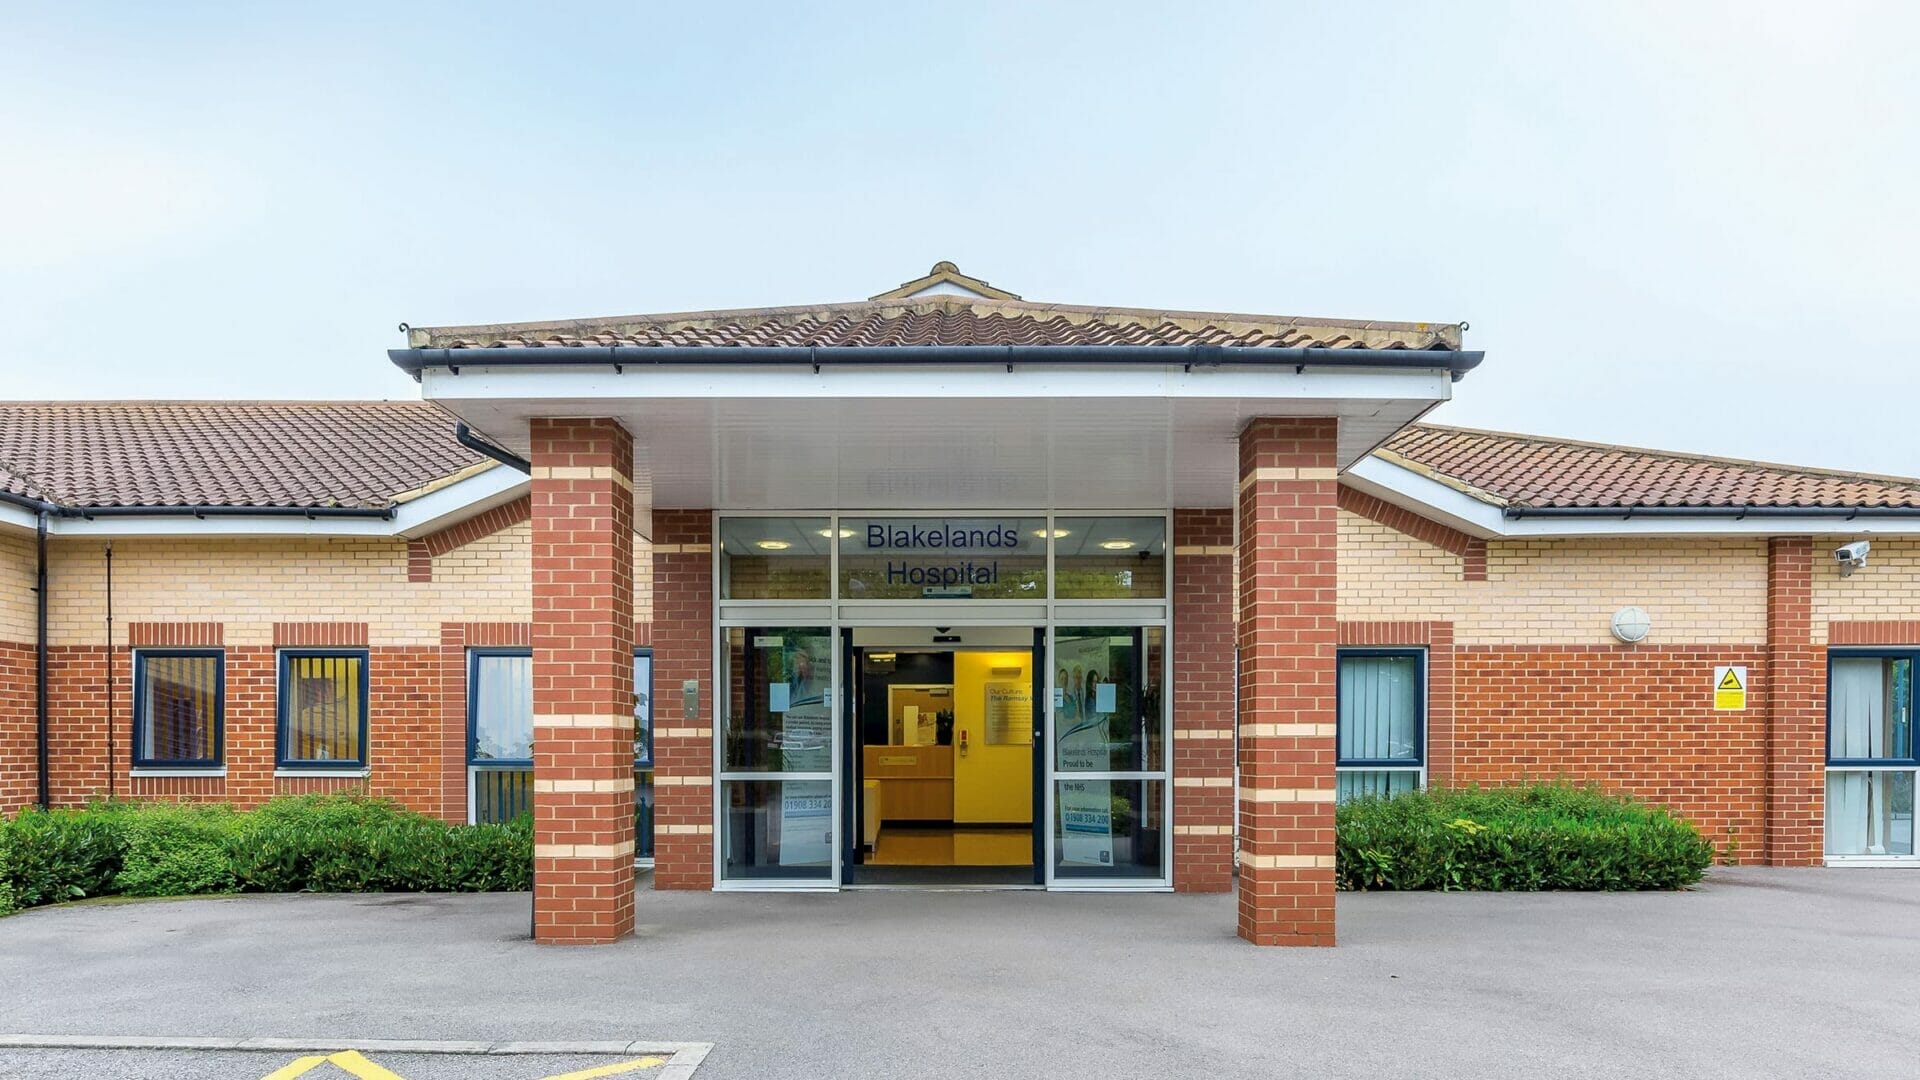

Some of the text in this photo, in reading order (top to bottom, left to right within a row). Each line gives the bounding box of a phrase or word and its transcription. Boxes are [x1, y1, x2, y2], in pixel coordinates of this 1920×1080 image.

[868, 524, 1018, 548] Blakelands
[888, 561, 998, 590] Hospital
[1063, 759, 1079, 768] Proud
[1086, 759, 1094, 768] be
[1064, 783, 1086, 791] the NHS
[784, 800, 832, 810] 01908 334 20
[1065, 812, 1109, 825] 01908 334 200
